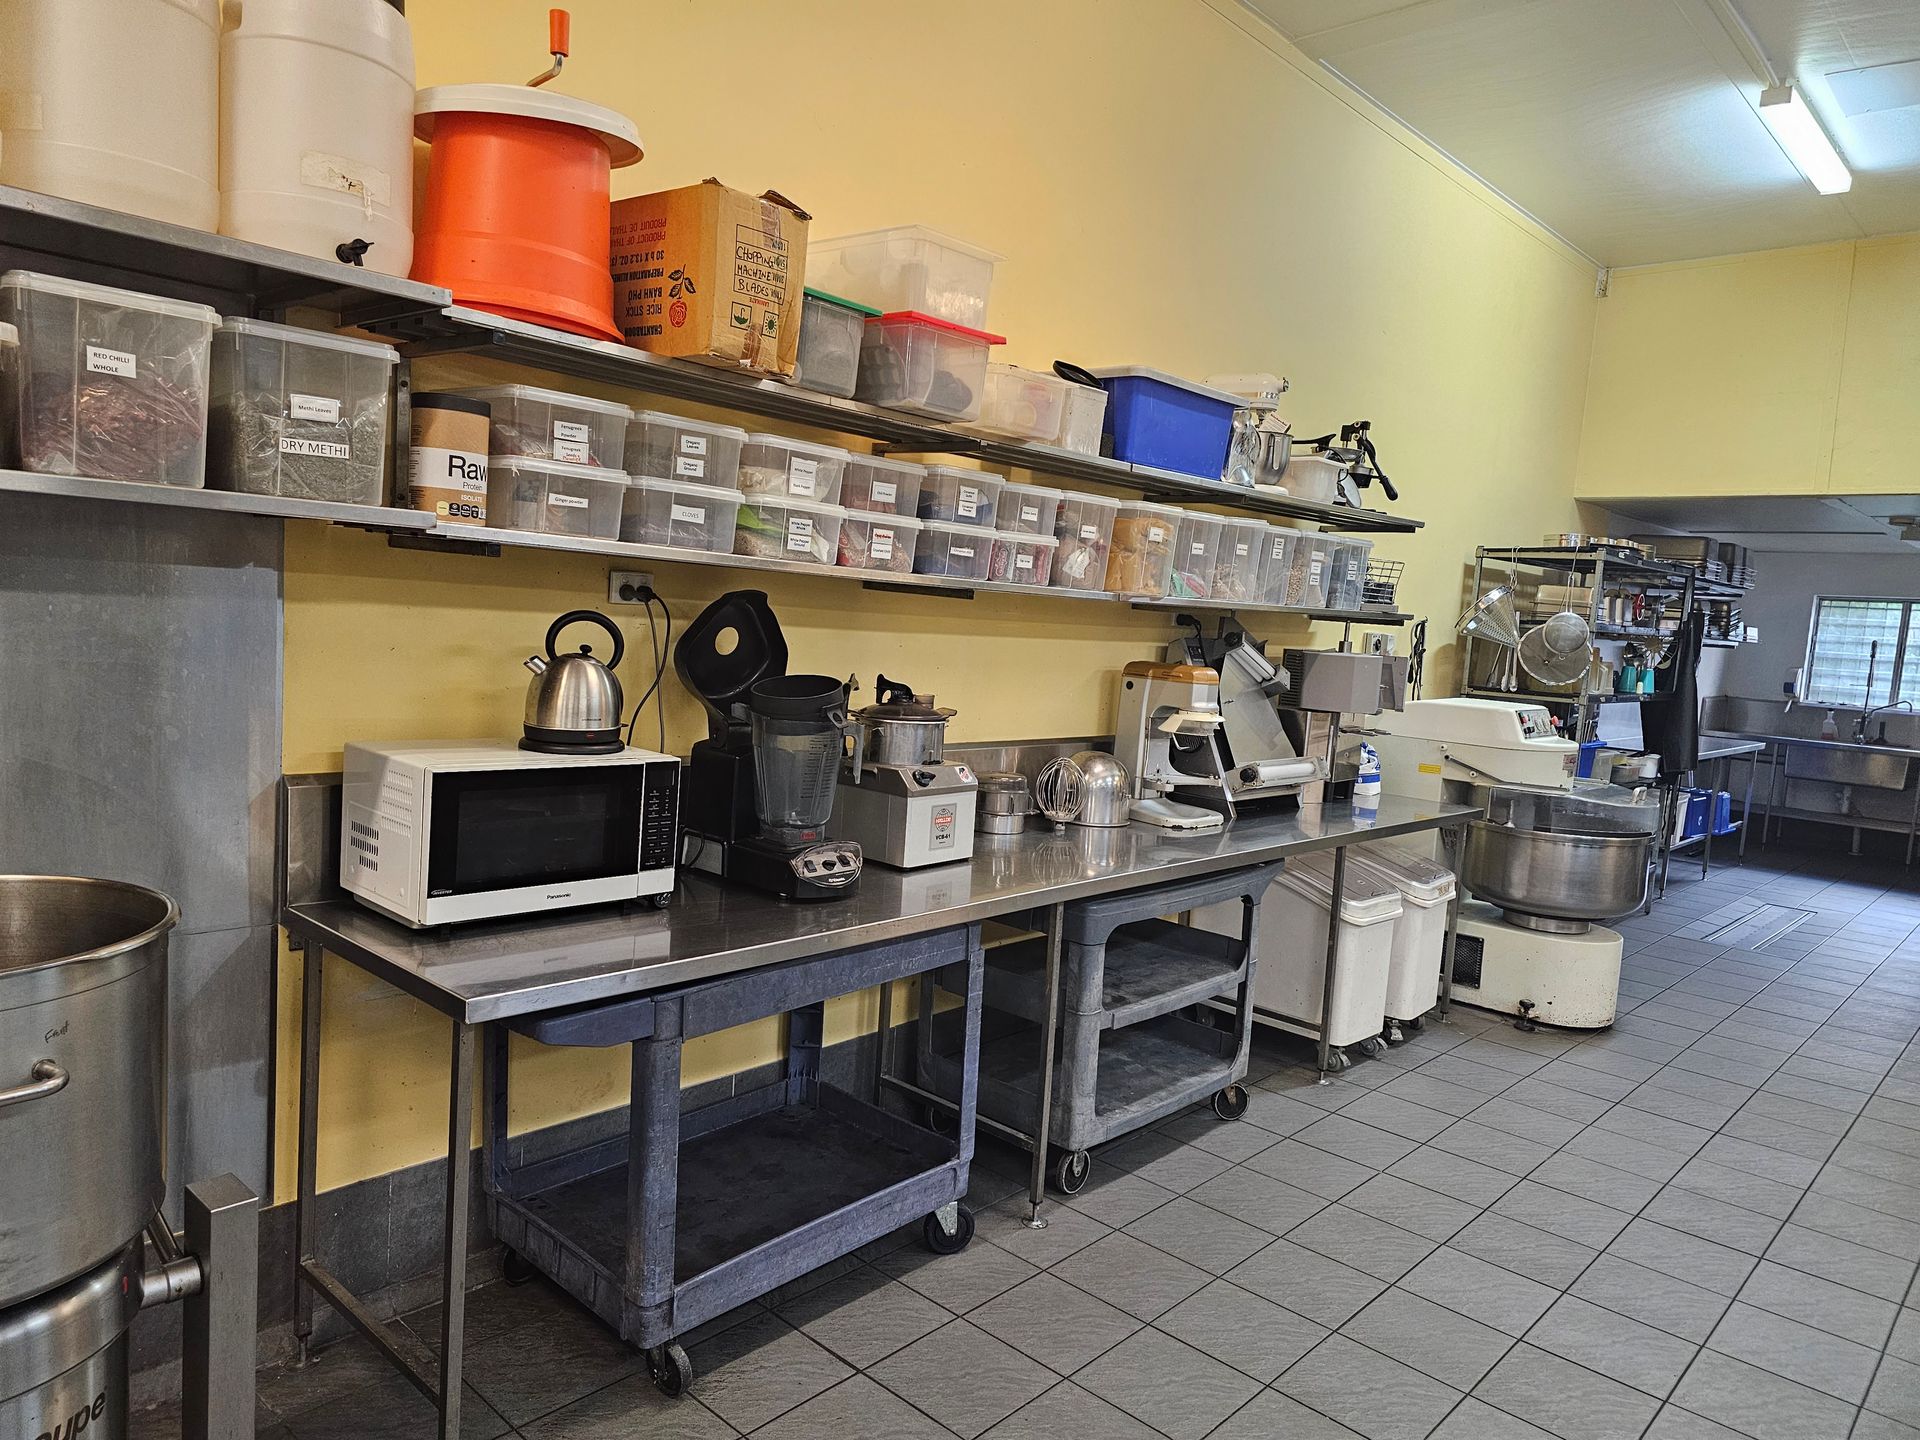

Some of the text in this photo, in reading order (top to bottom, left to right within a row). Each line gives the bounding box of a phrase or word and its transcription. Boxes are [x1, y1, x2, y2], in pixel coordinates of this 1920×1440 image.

[637, 231, 666, 245] PRODUCT
[656, 250, 665, 261] 30
[736, 246, 774, 268] CHOPPING
[629, 267, 664, 280] PREPARATION
[737, 264, 772, 282] MACHINE
[738, 278, 769, 297] BLADES
[625, 304, 662, 318] RICE STICK
[93, 352, 130, 364] RED CHILLI
[93, 363, 119, 373] WHOLE
[281, 440, 347, 457] DRY METHI
[448, 454, 487, 482] Raw
[682, 511, 699, 519] CLOVES
